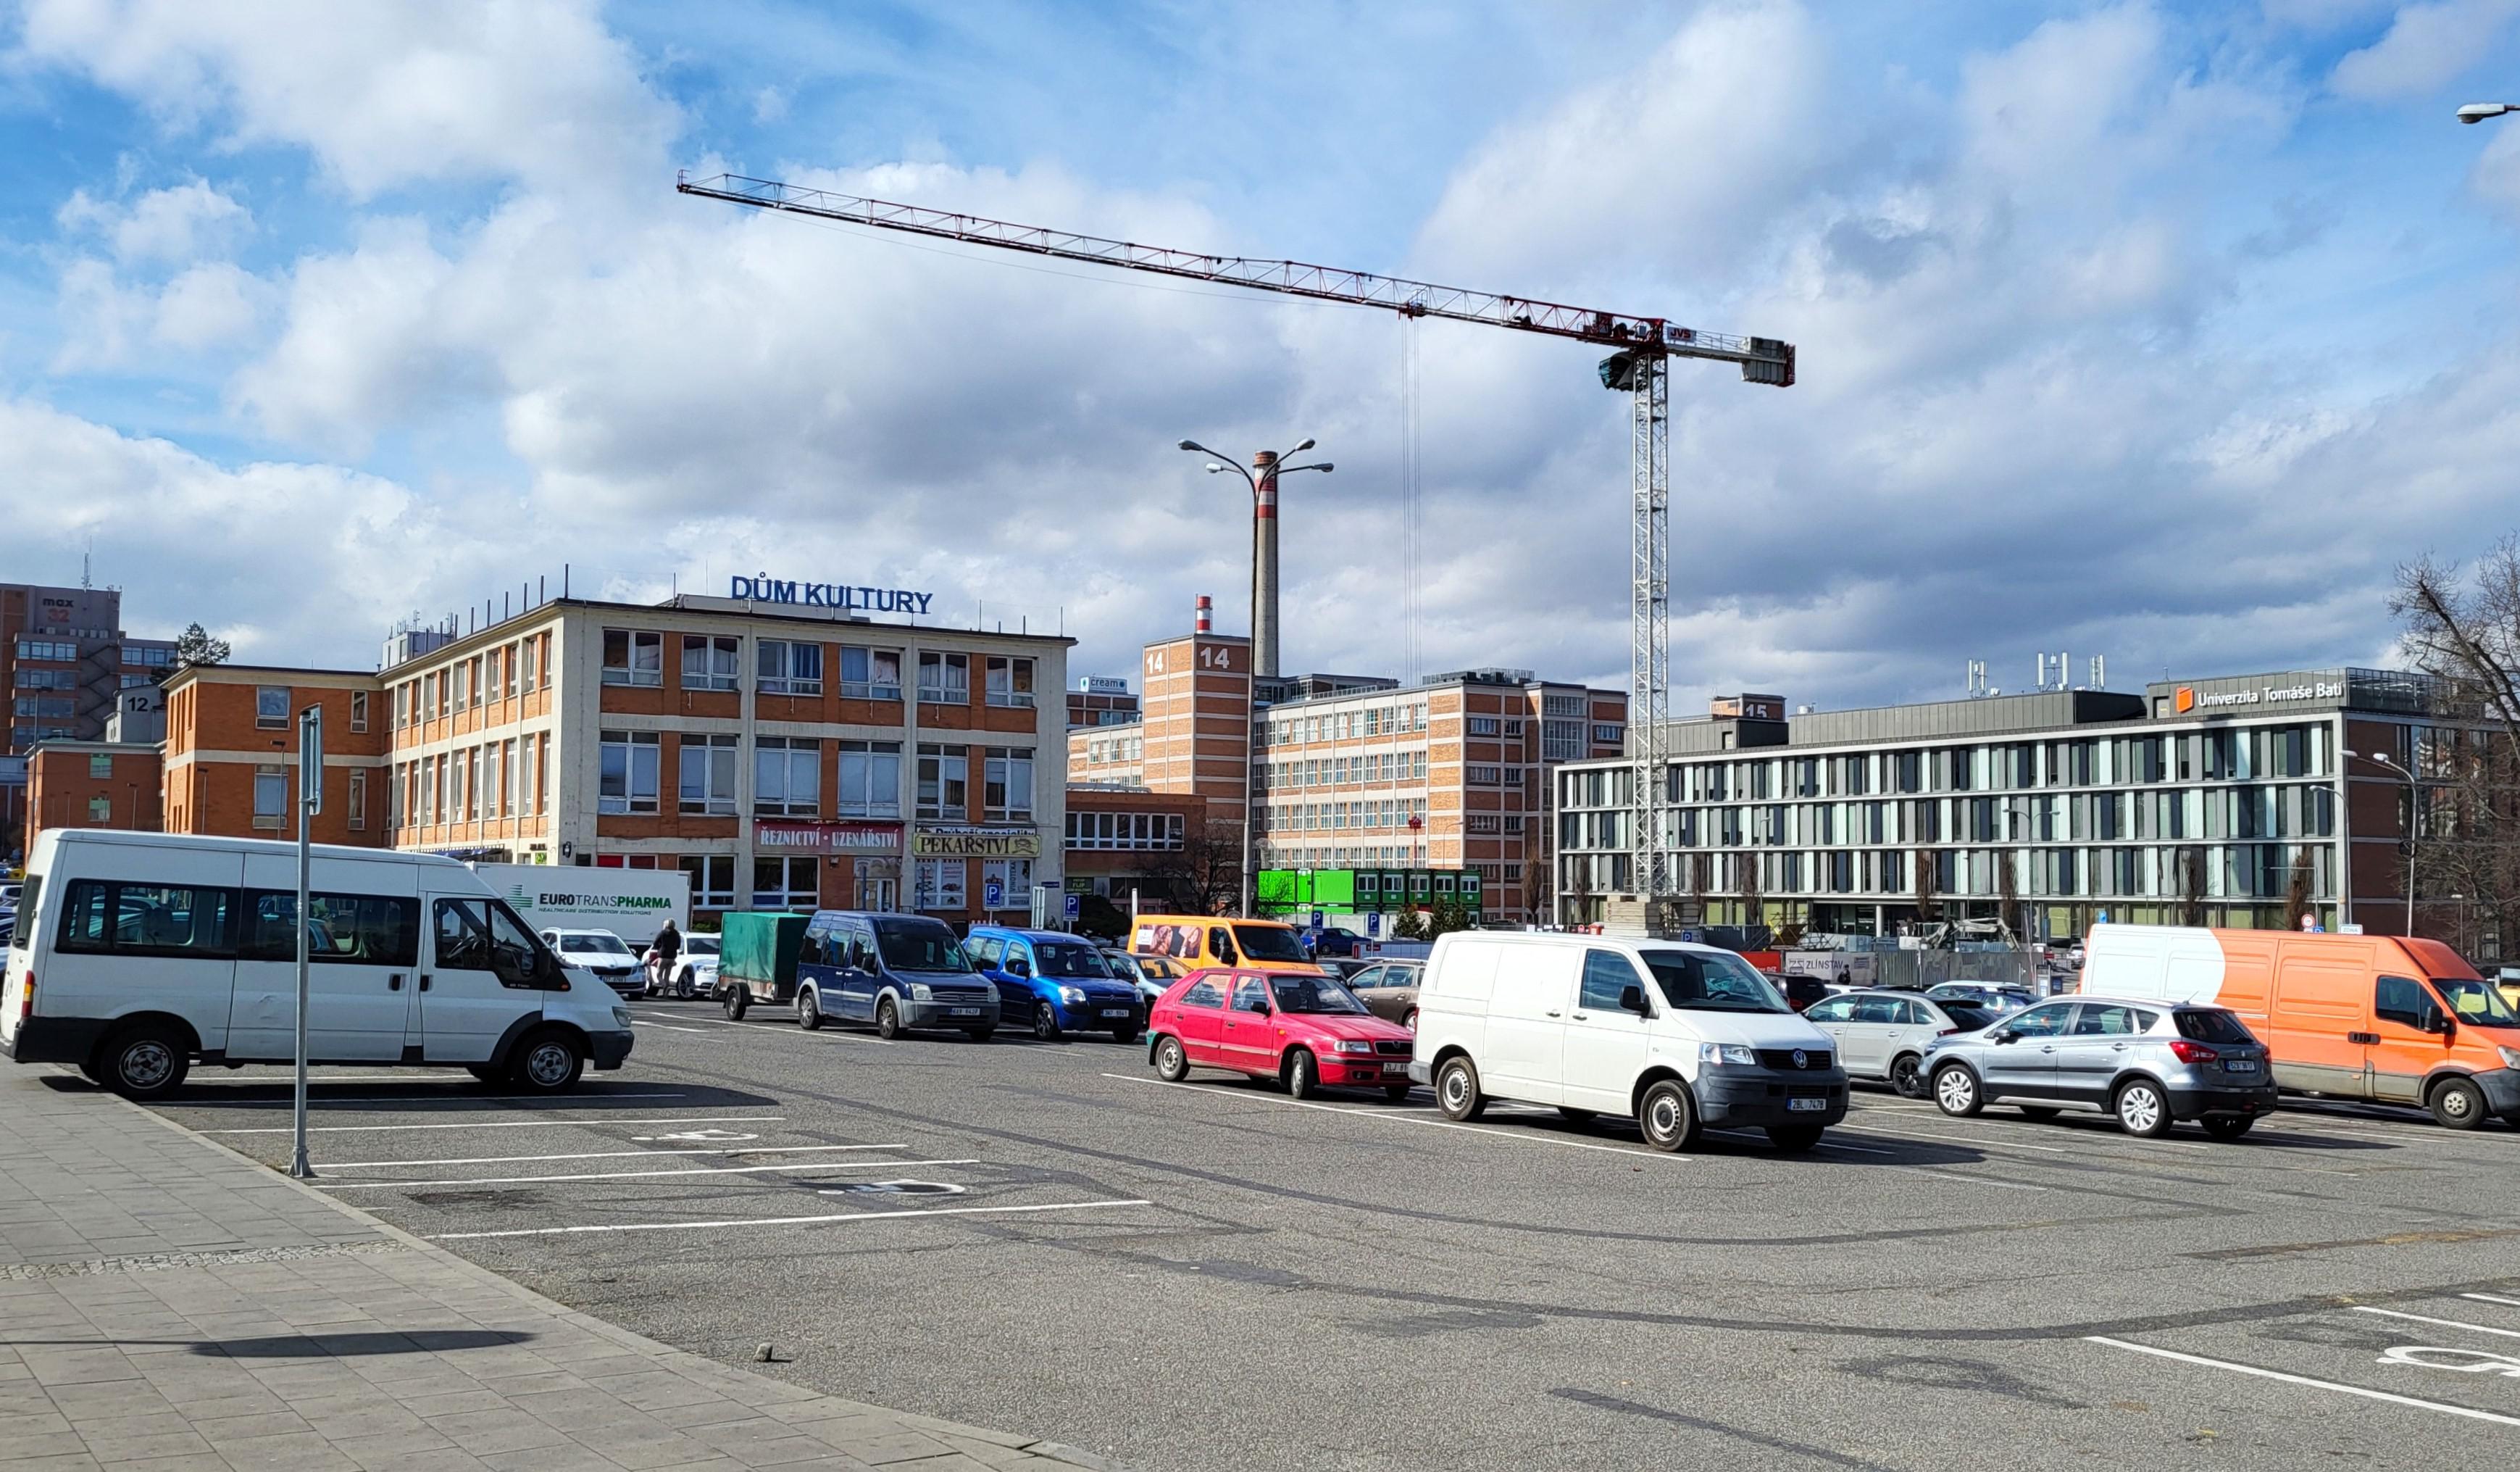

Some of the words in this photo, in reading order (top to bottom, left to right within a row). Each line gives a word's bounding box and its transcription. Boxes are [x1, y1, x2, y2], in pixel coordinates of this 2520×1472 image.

[1670, 328, 1691, 338] JVS
[731, 571, 796, 604] DŮM
[805, 582, 933, 614] KULTURY
[43, 598, 74, 607] max
[49, 608, 70, 623] 32
[1147, 652, 1164, 674] 14
[1200, 646, 1230, 669] 14
[1090, 678, 1119, 688] cream
[2198, 689, 2259, 707] Univerzita
[2262, 685, 2314, 702] Tomáše
[2316, 682, 2342, 698] Bati
[128, 697, 149, 712] 12
[1745, 704, 1767, 718] 15
[761, 826, 821, 846] ŘEZNICTVÍ
[832, 828, 898, 848] UZENÁŘSTVÍ
[920, 836, 1010, 854] PEKAŘSTVÍ
[989, 886, 998, 899] P
[539, 893, 672, 909] EUROTRANSPHARMA
[1067, 897, 1076, 910] P
[1314, 912, 1321, 924] P
[1370, 915, 1377, 926] P
[1806, 959, 1843, 970] ZLÍNSTAV
